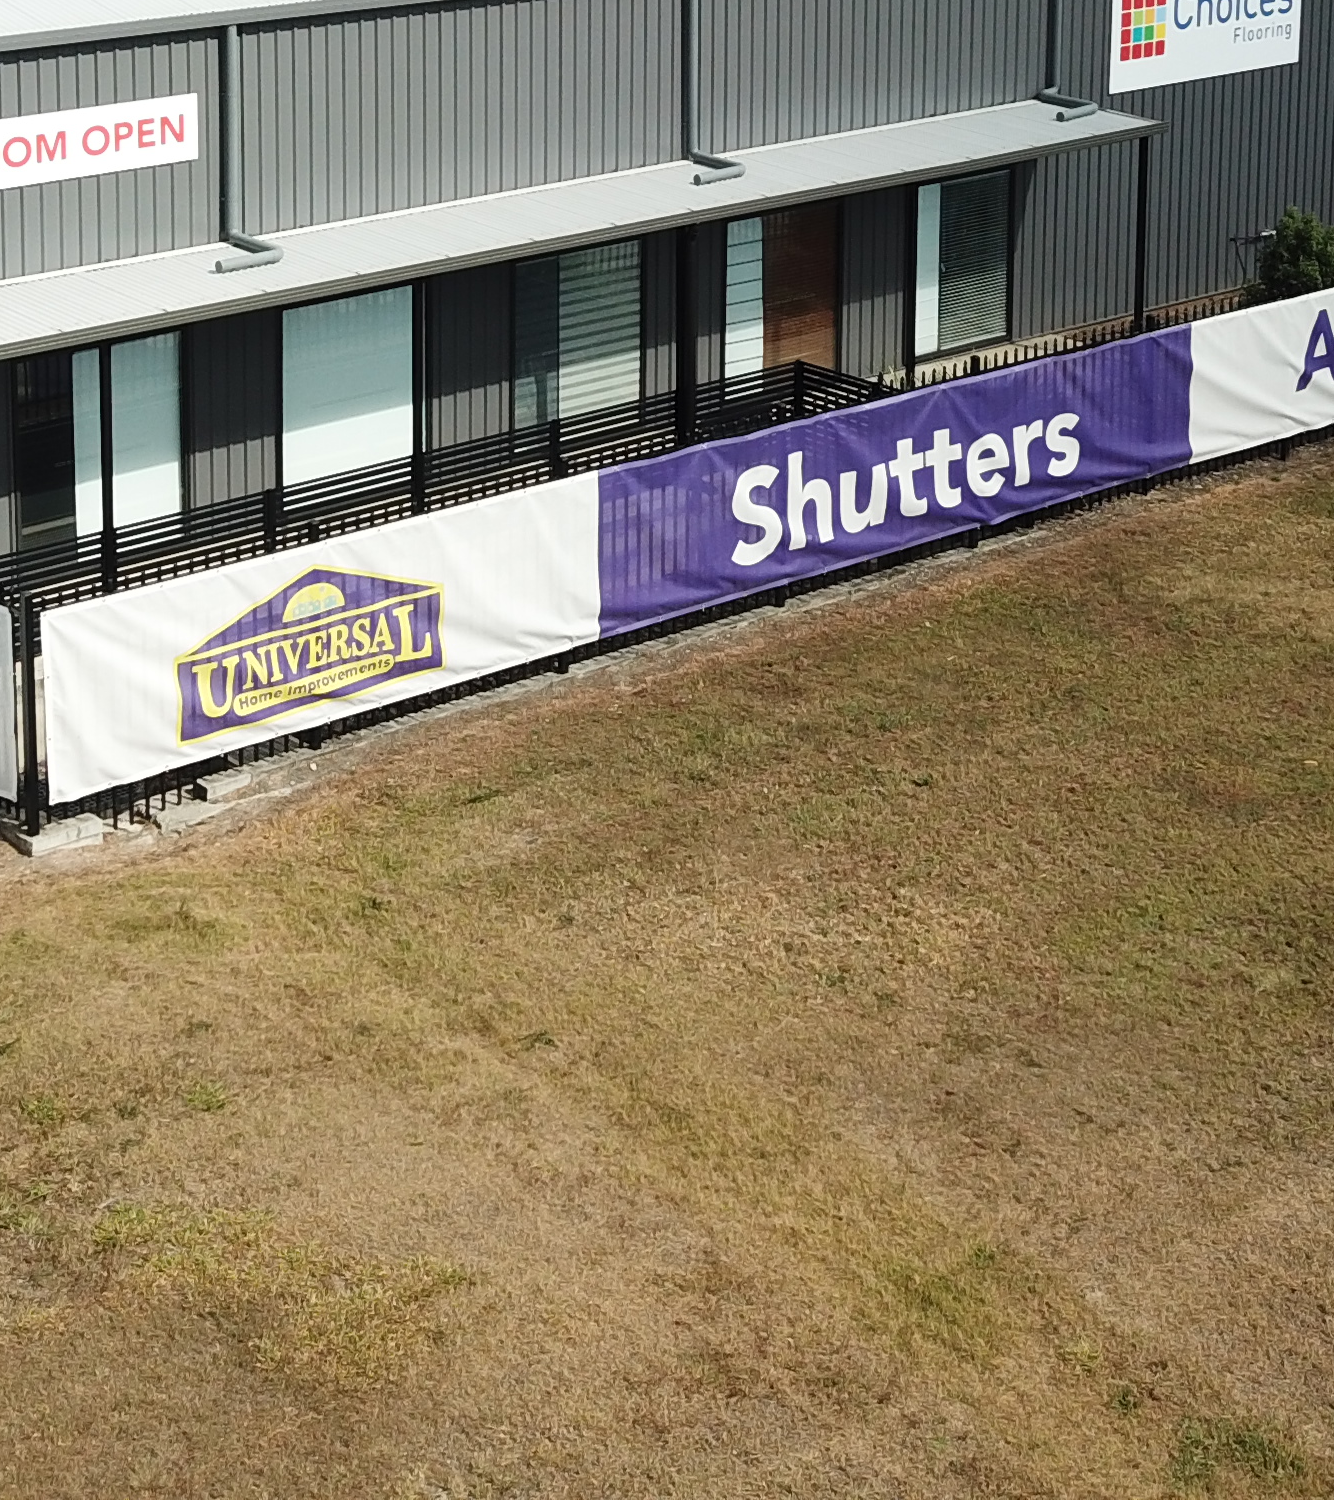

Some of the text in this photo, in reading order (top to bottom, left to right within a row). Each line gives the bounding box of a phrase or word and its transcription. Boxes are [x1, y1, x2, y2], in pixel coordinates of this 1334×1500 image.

[1233, 22, 1292, 44] Flooring
[81, 114, 185, 156] OPEN
[730, 412, 1082, 567] Shutters
[191, 604, 432, 718] UNIVERSAL
[239, 656, 391, 709] Home Improvements
